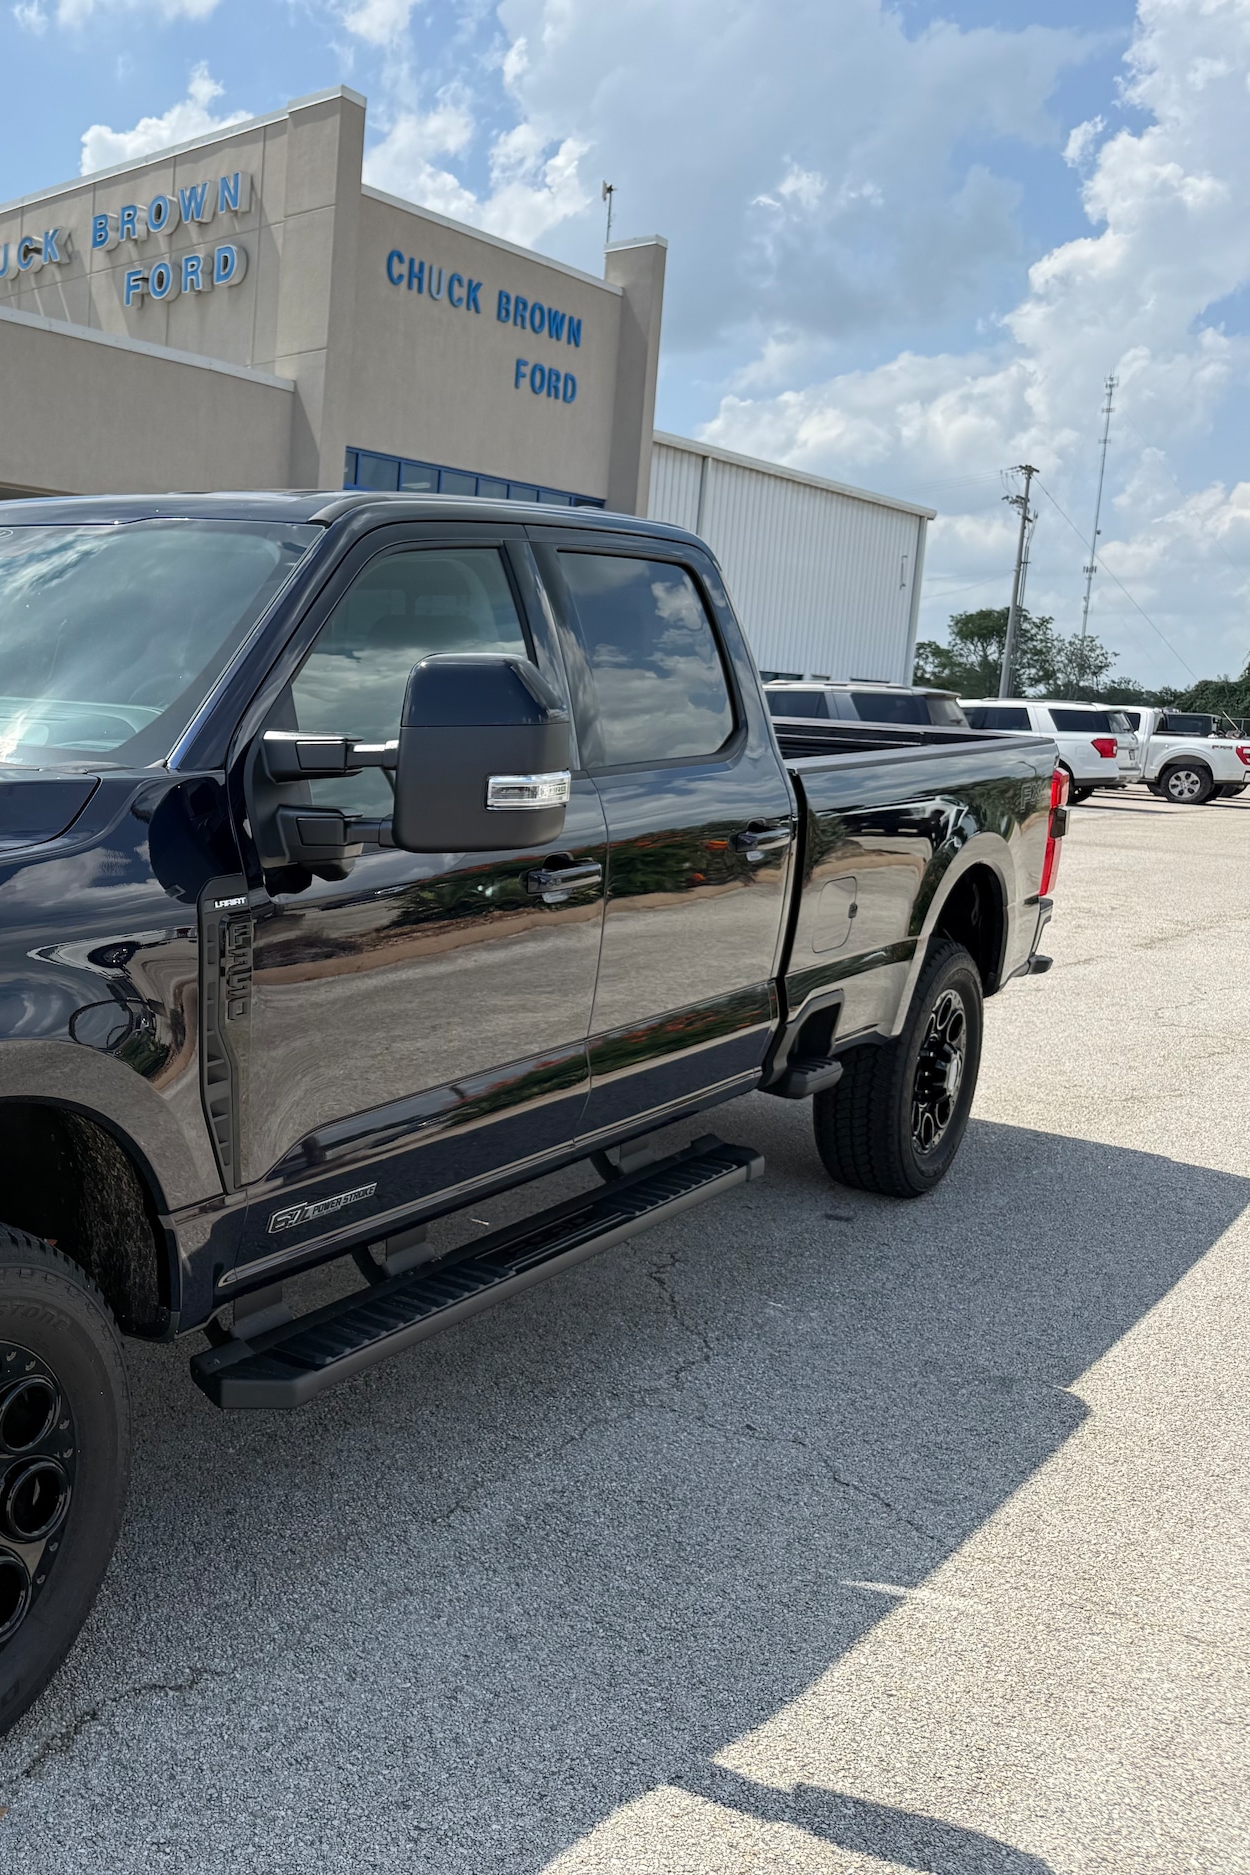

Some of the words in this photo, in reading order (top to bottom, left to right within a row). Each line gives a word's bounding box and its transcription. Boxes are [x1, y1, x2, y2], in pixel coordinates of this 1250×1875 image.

[92, 171, 245, 250] BROWN
[125, 245, 243, 308] FORD
[387, 249, 483, 314] CHUCK
[497, 290, 582, 348] BROWN
[515, 358, 577, 403] FORD
[214, 896, 246, 908] LARIAT
